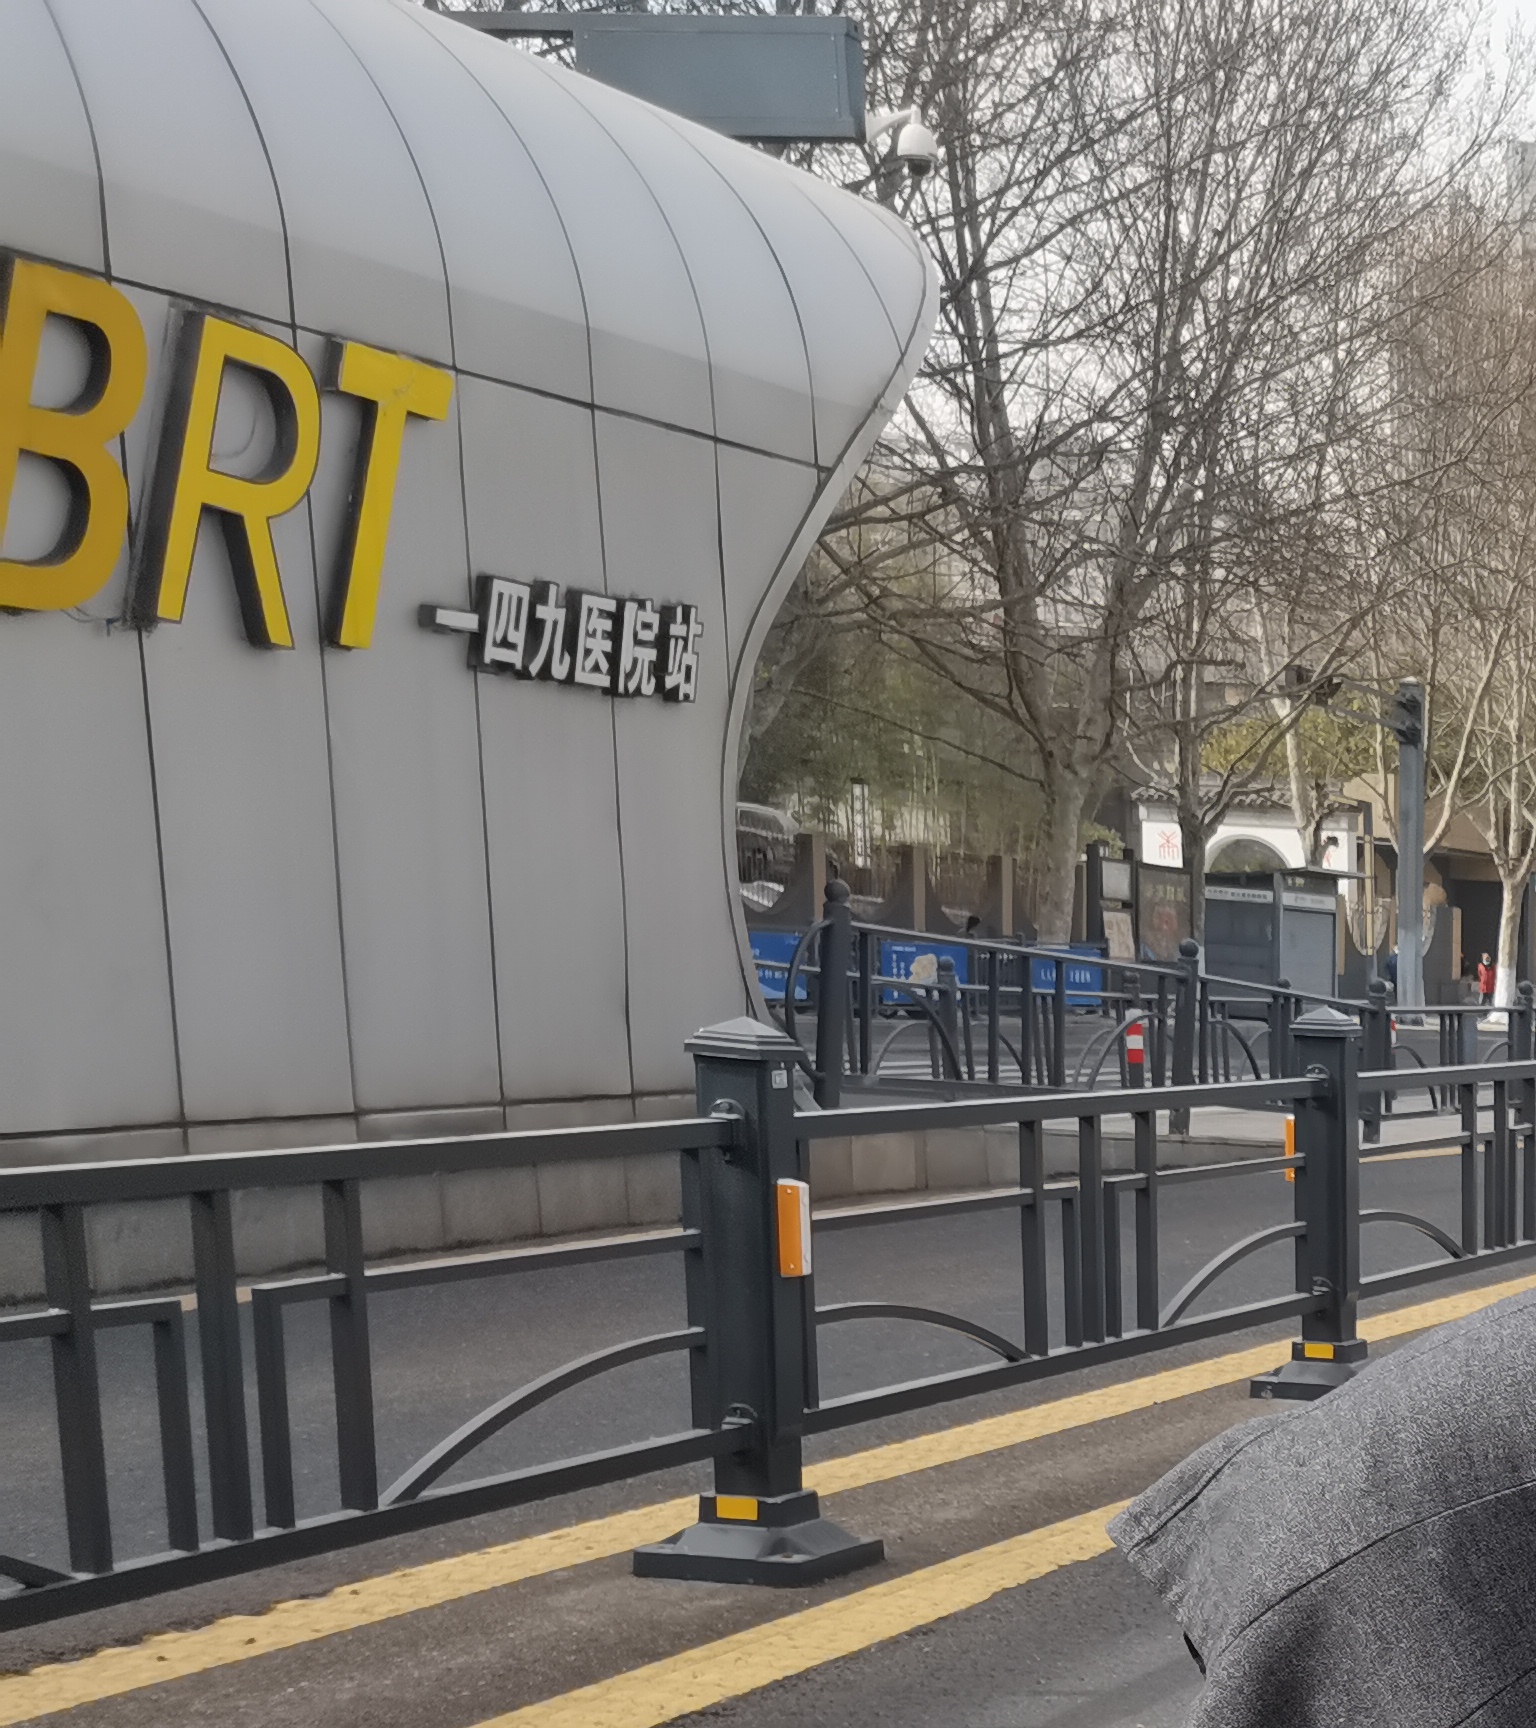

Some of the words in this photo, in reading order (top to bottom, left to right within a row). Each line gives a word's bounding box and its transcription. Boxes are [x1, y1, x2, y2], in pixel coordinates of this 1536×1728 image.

[0, 256, 455, 651] BRT
[428, 576, 704, 703] 一四九医院站
